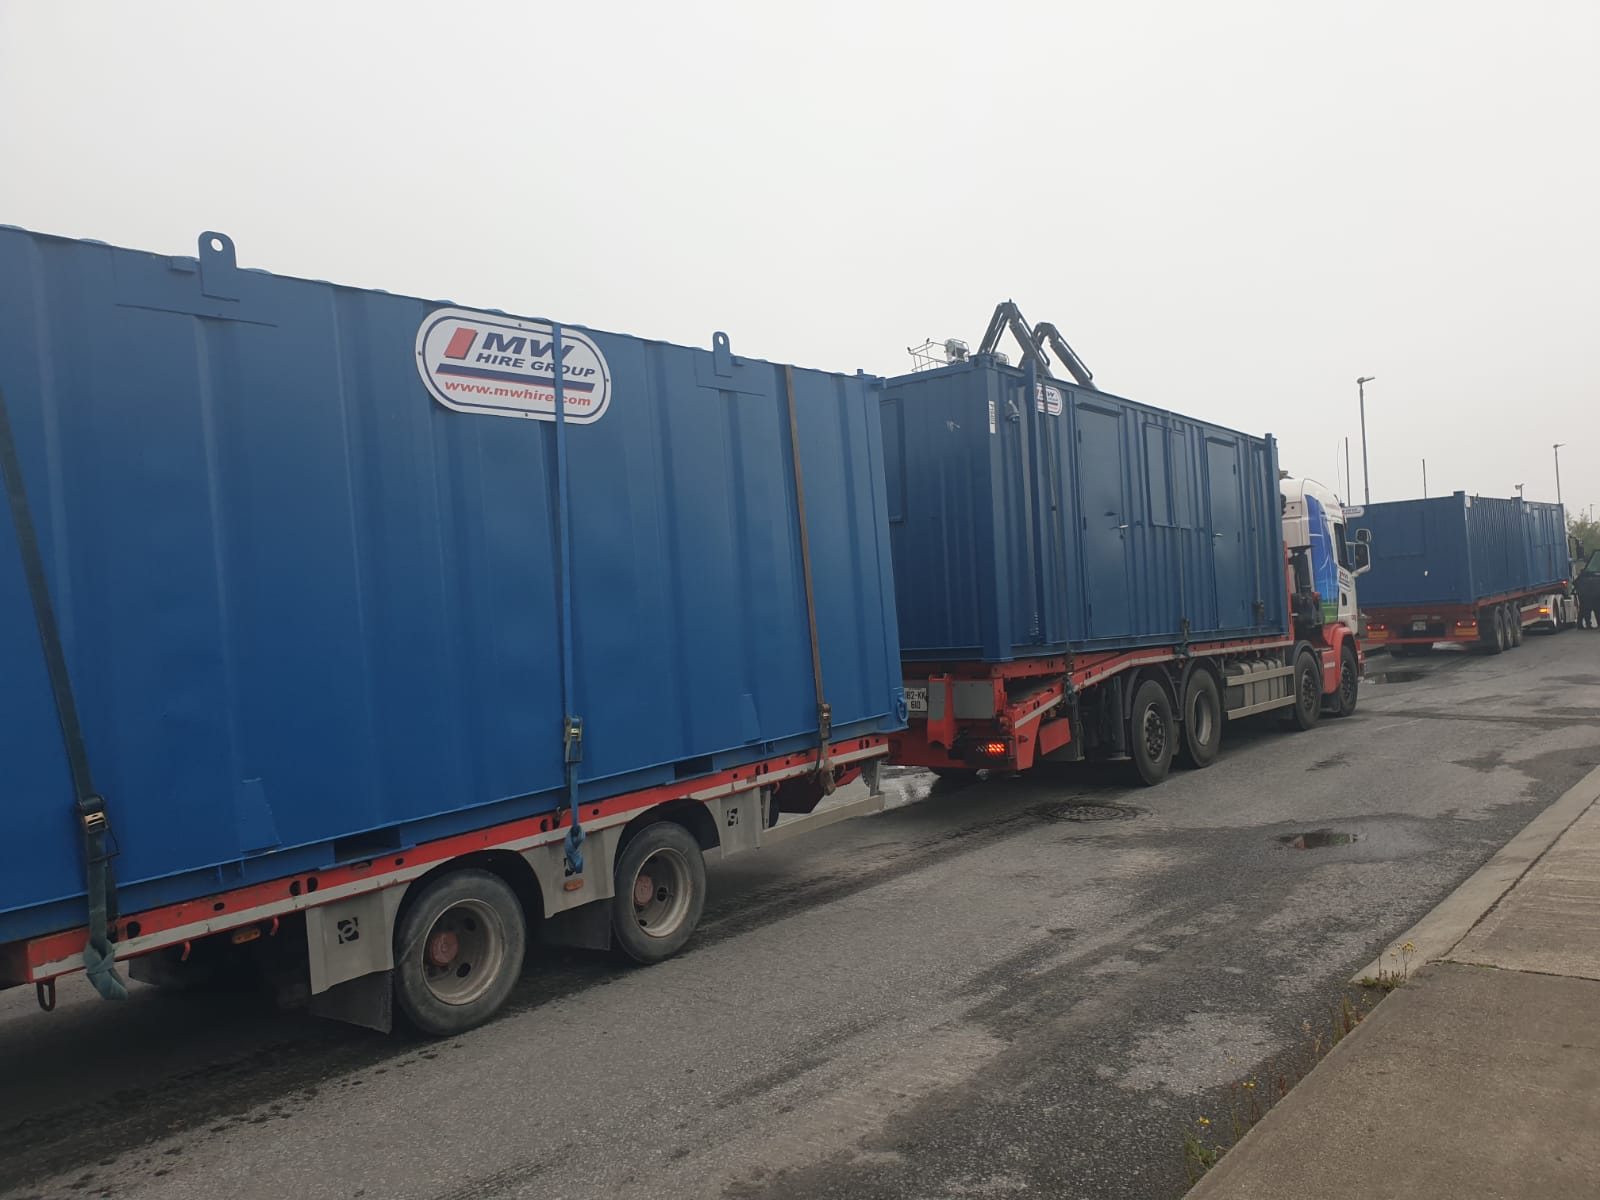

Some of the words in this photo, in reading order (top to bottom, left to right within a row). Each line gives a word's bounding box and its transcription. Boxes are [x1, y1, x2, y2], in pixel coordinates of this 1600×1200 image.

[482, 332, 575, 359] MW
[476, 352, 525, 368] HIRE
[531, 361, 595, 377] GROUP
